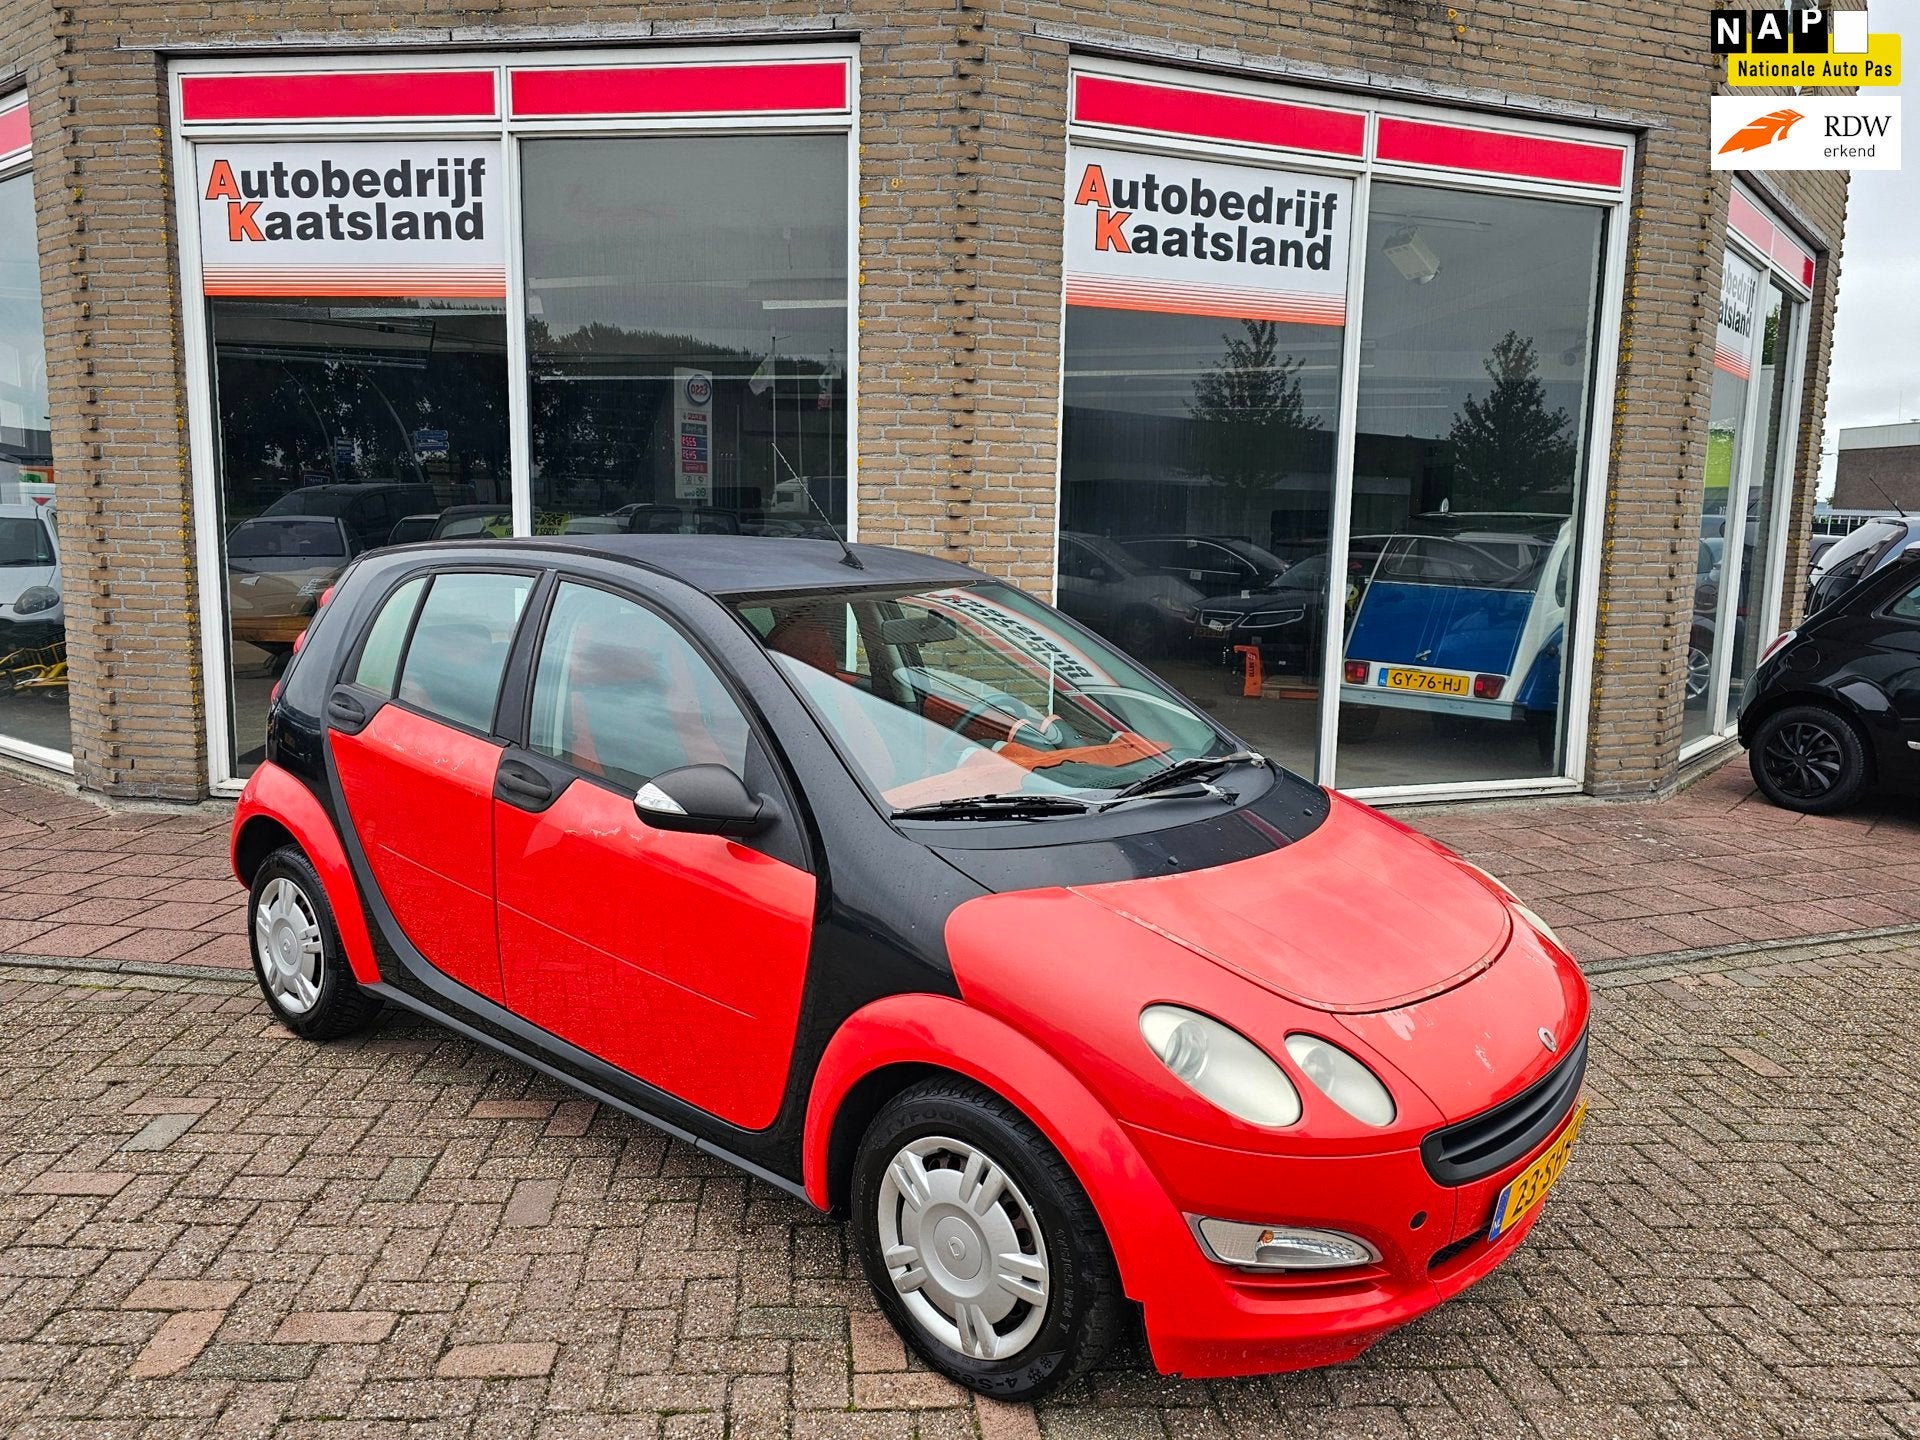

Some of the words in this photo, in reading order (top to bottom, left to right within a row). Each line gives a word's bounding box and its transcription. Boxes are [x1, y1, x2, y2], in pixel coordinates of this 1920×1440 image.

[205, 158, 486, 208] Autobedrijf
[1075, 164, 1338, 238] Autobedrijf
[228, 202, 484, 241] Kaatsland
[1095, 208, 1331, 270] Kaatsland
[1391, 671, 1463, 692] GY-76-HJ
